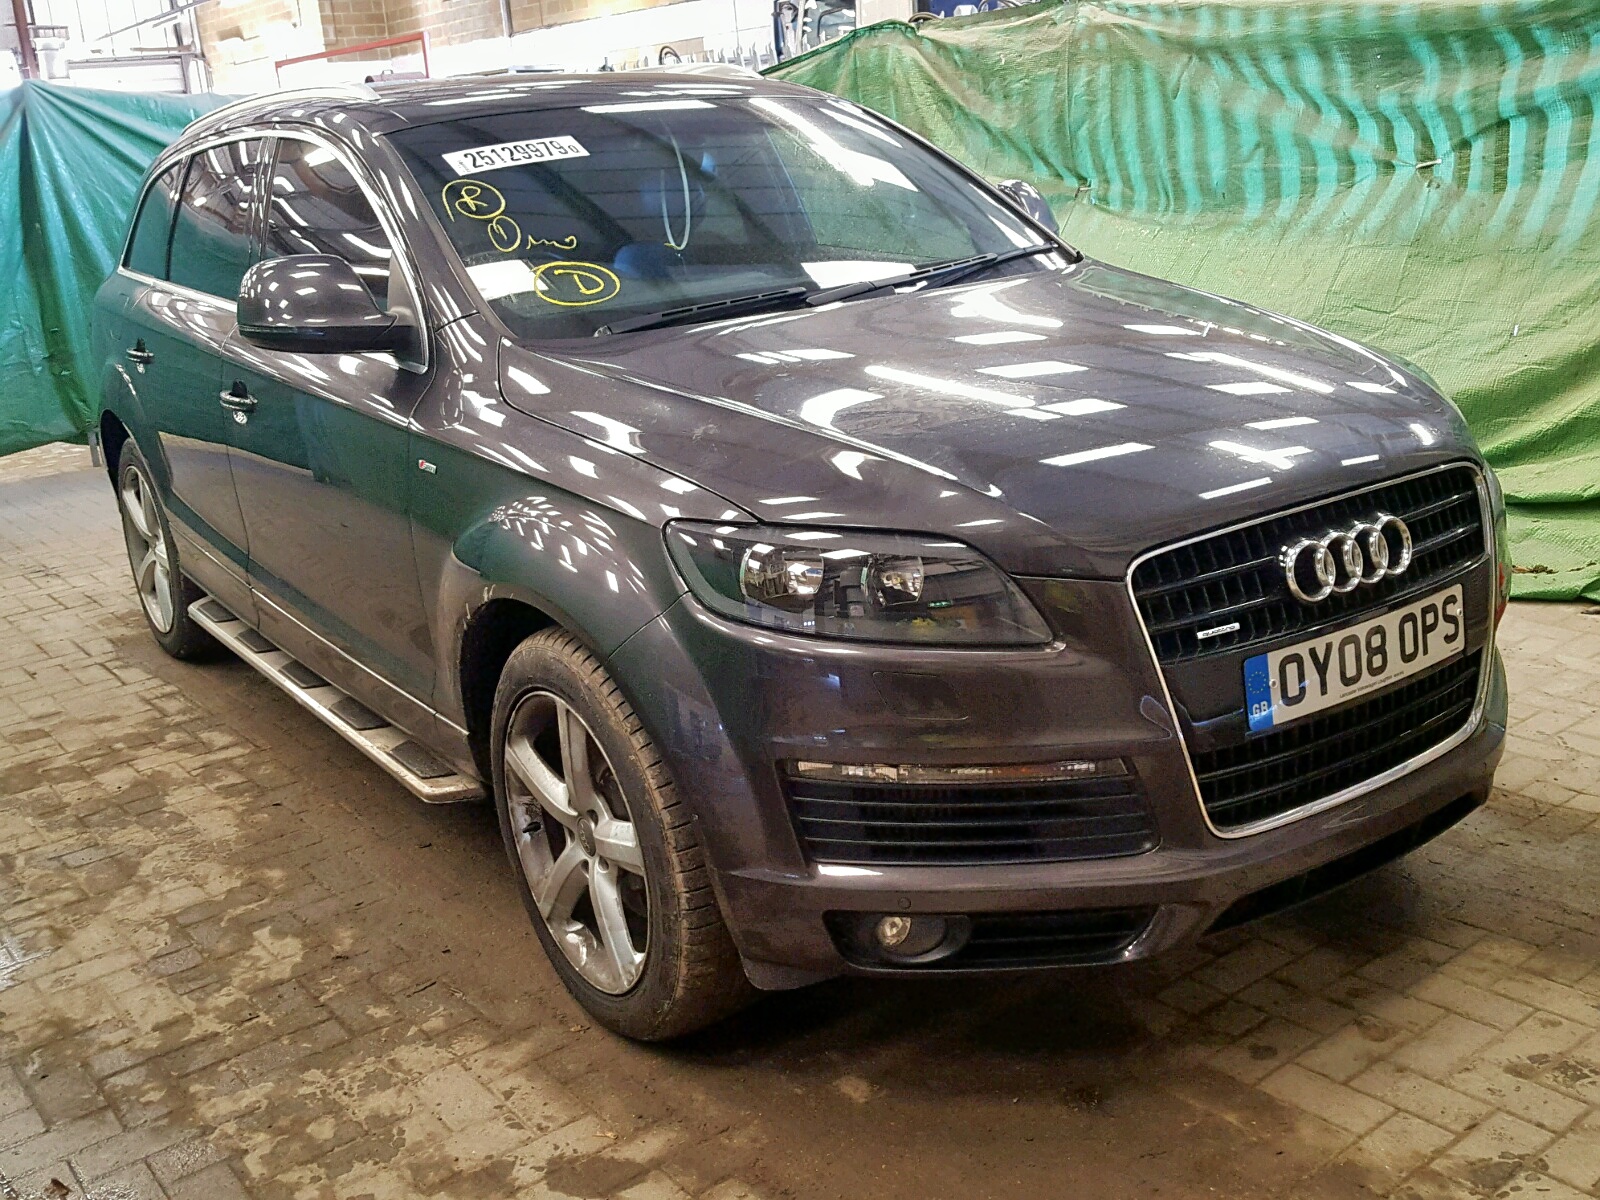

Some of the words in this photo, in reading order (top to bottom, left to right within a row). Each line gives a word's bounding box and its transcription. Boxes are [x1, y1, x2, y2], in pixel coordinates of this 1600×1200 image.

[1278, 624, 1388, 707] OY08
[1400, 593, 1460, 664] OPS
[1253, 701, 1268, 717] GB
